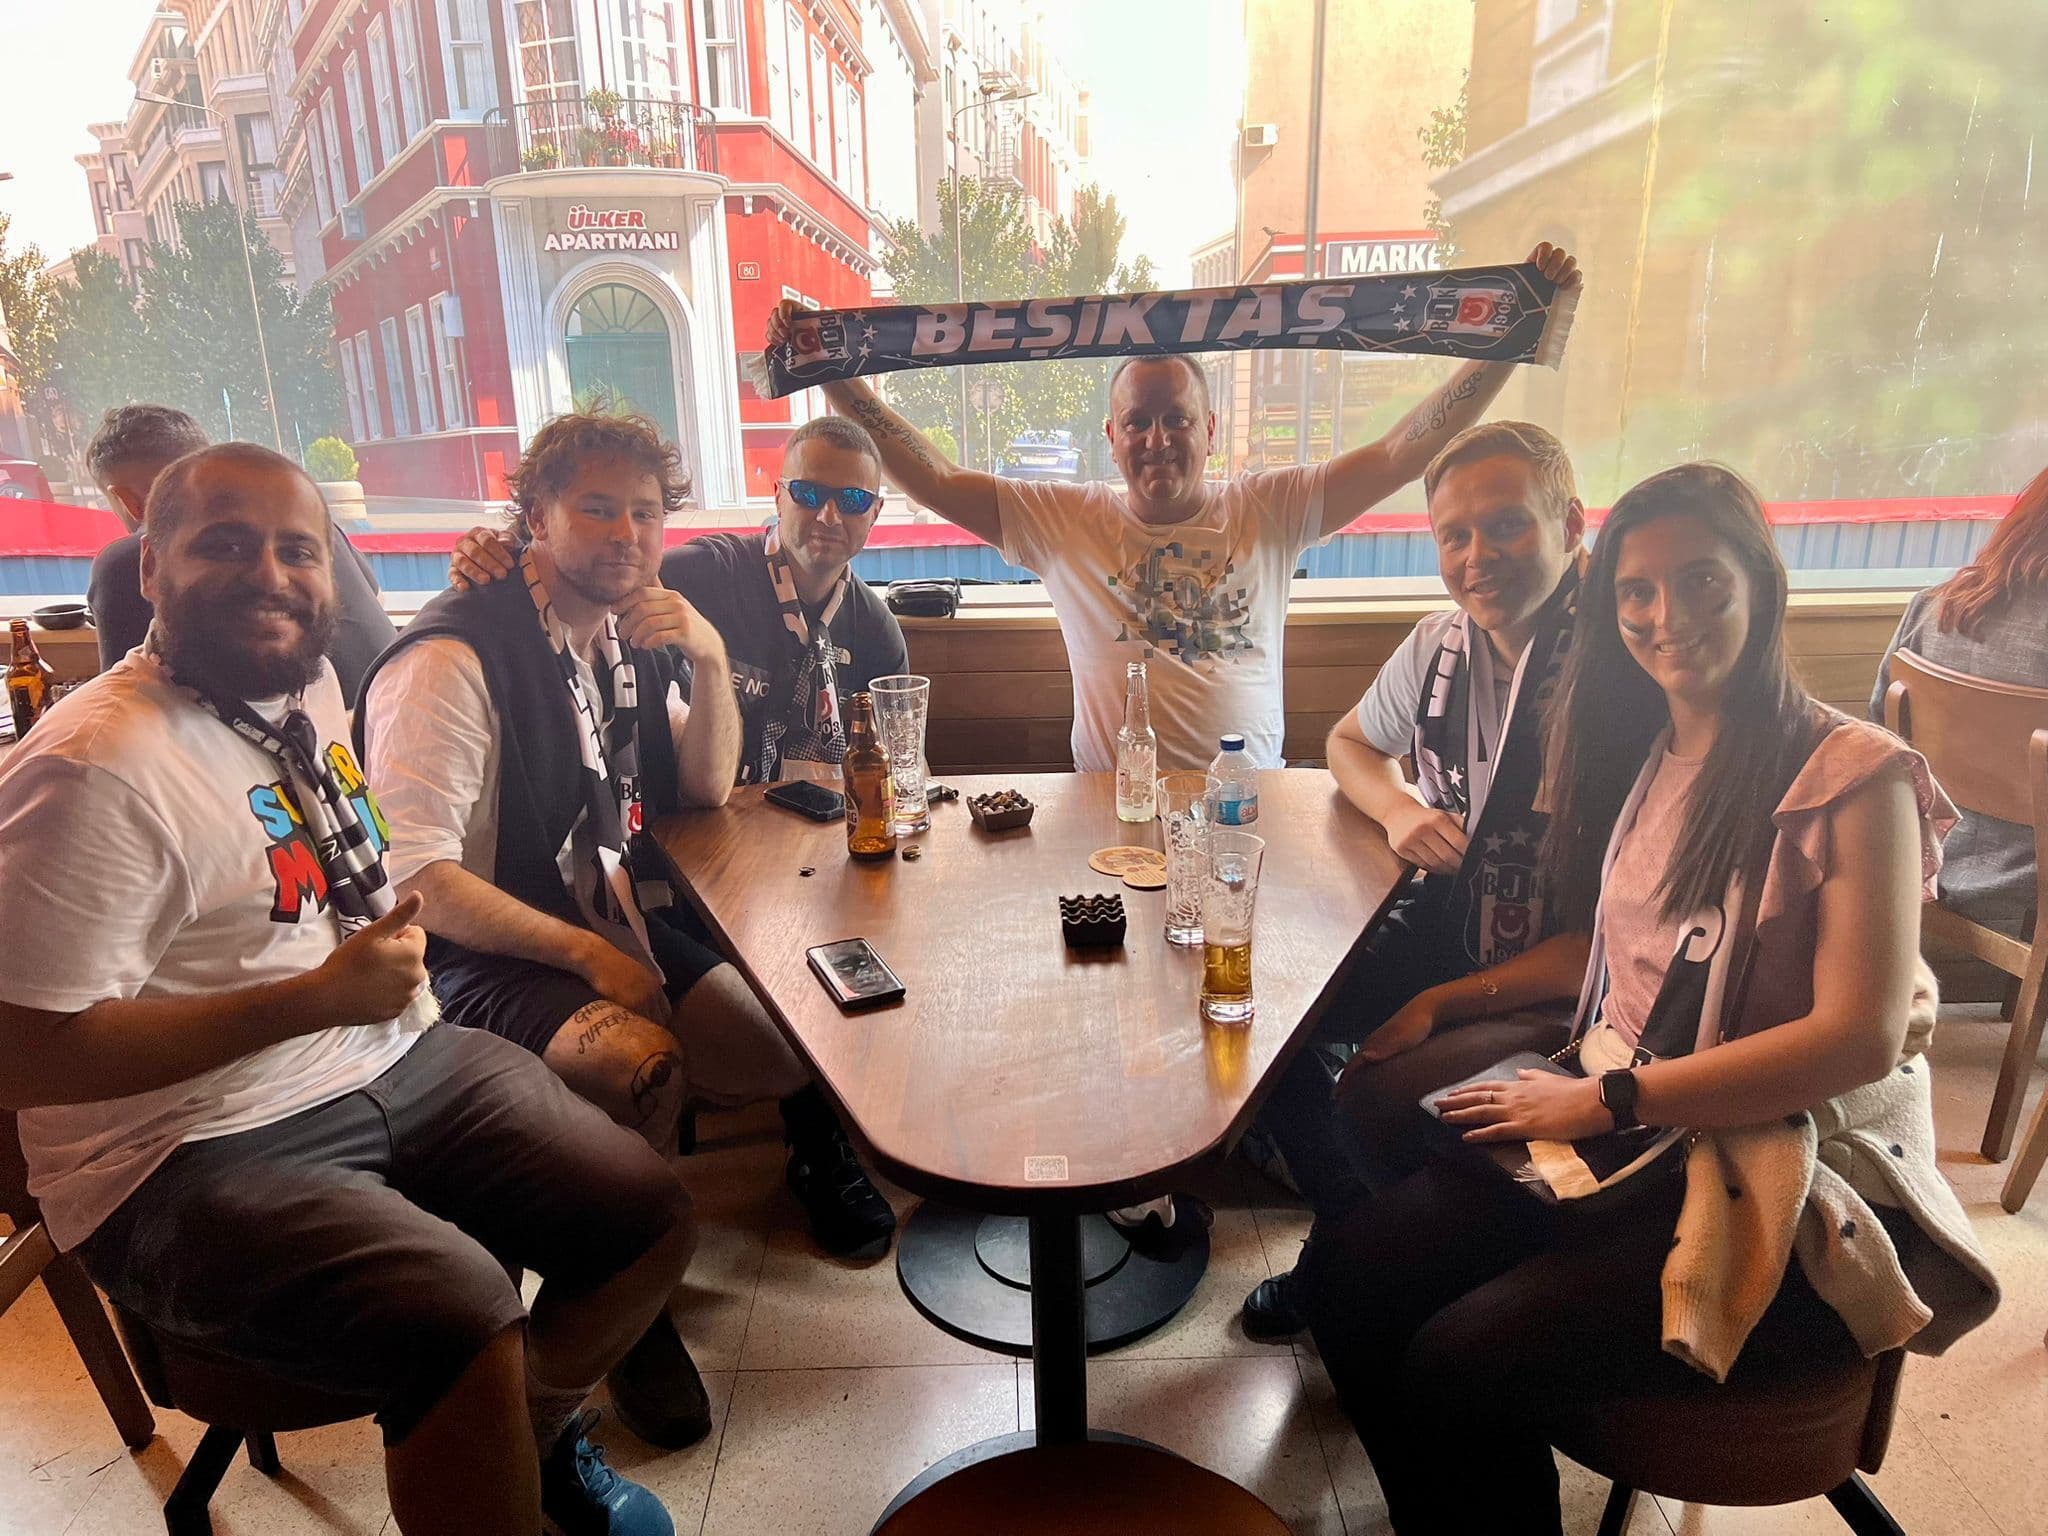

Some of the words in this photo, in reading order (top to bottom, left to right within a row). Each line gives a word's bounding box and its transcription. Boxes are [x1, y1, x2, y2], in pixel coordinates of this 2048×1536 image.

[568, 204, 646, 231] ÜLKER
[544, 231, 679, 251] APARTMANI
[743, 265, 755, 277] 80
[911, 284, 1355, 357] BEŞİKTAŞ
[1431, 288, 1457, 330] BJK
[1493, 293, 1514, 333] 1903
